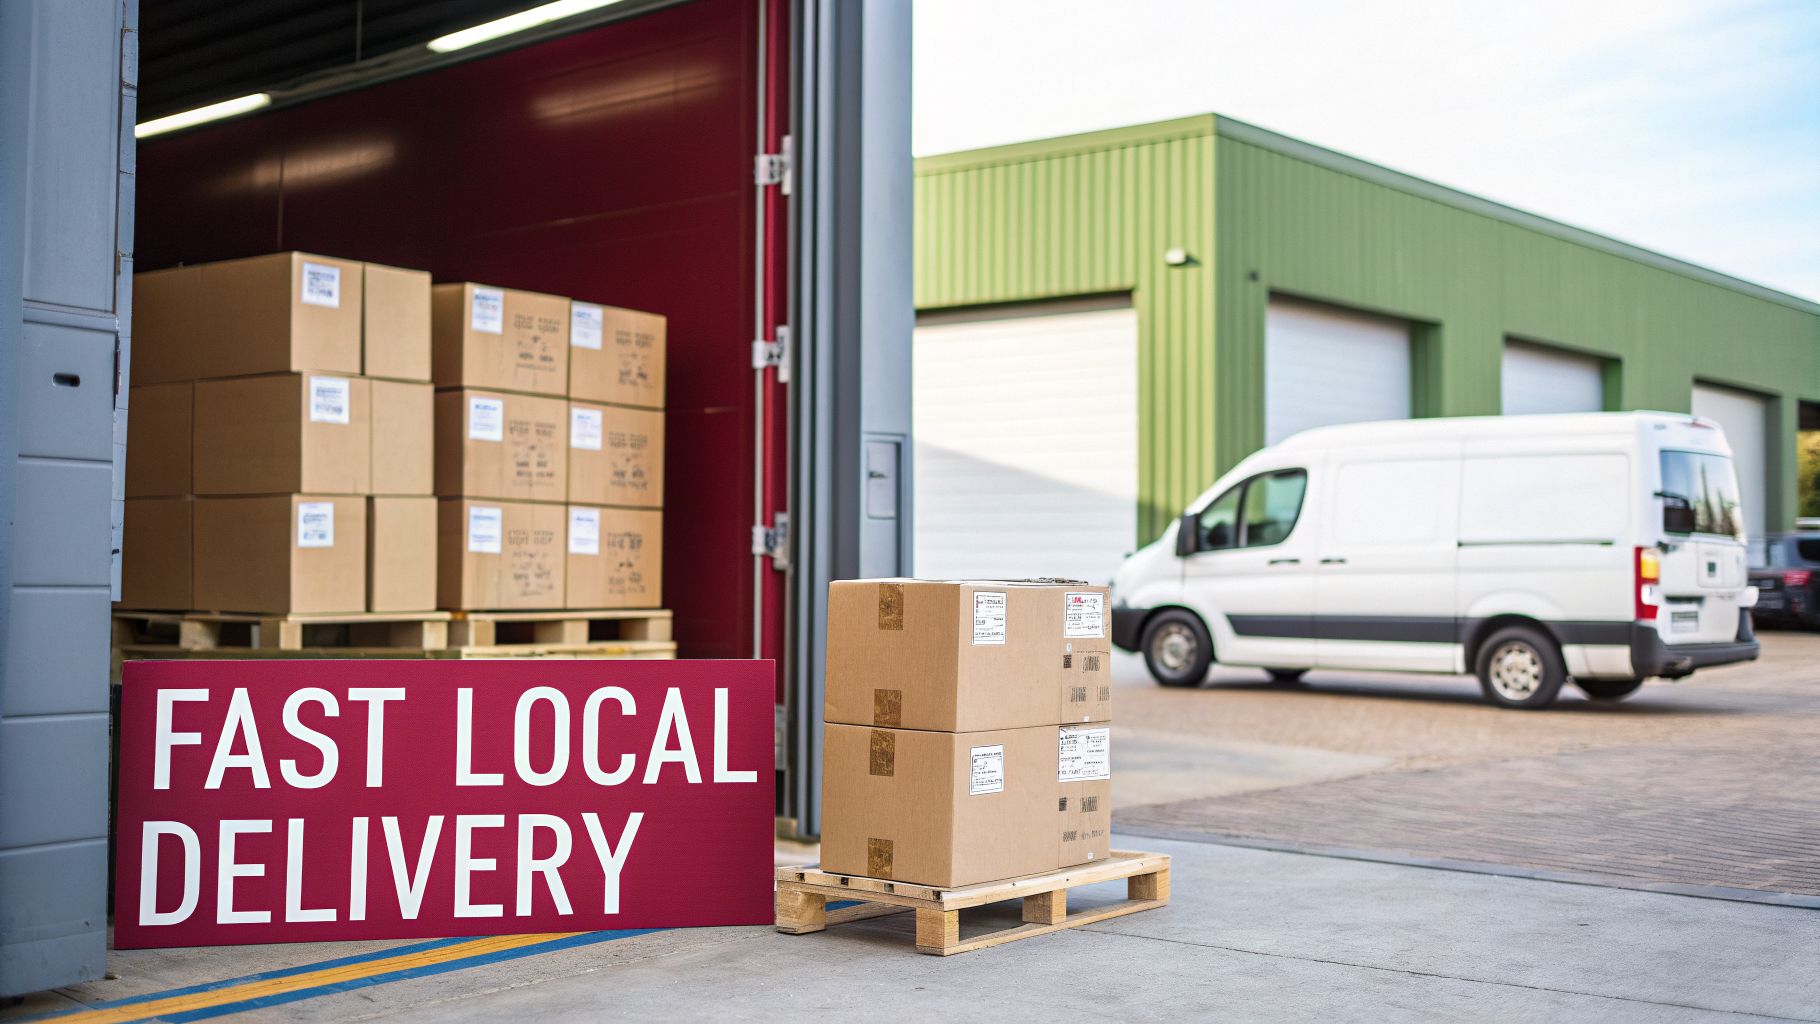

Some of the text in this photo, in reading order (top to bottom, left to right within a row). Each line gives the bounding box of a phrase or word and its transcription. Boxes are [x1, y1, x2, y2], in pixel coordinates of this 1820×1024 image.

[153, 686, 758, 790] FAST LOCAL
[138, 812, 645, 926] DELIVERY
